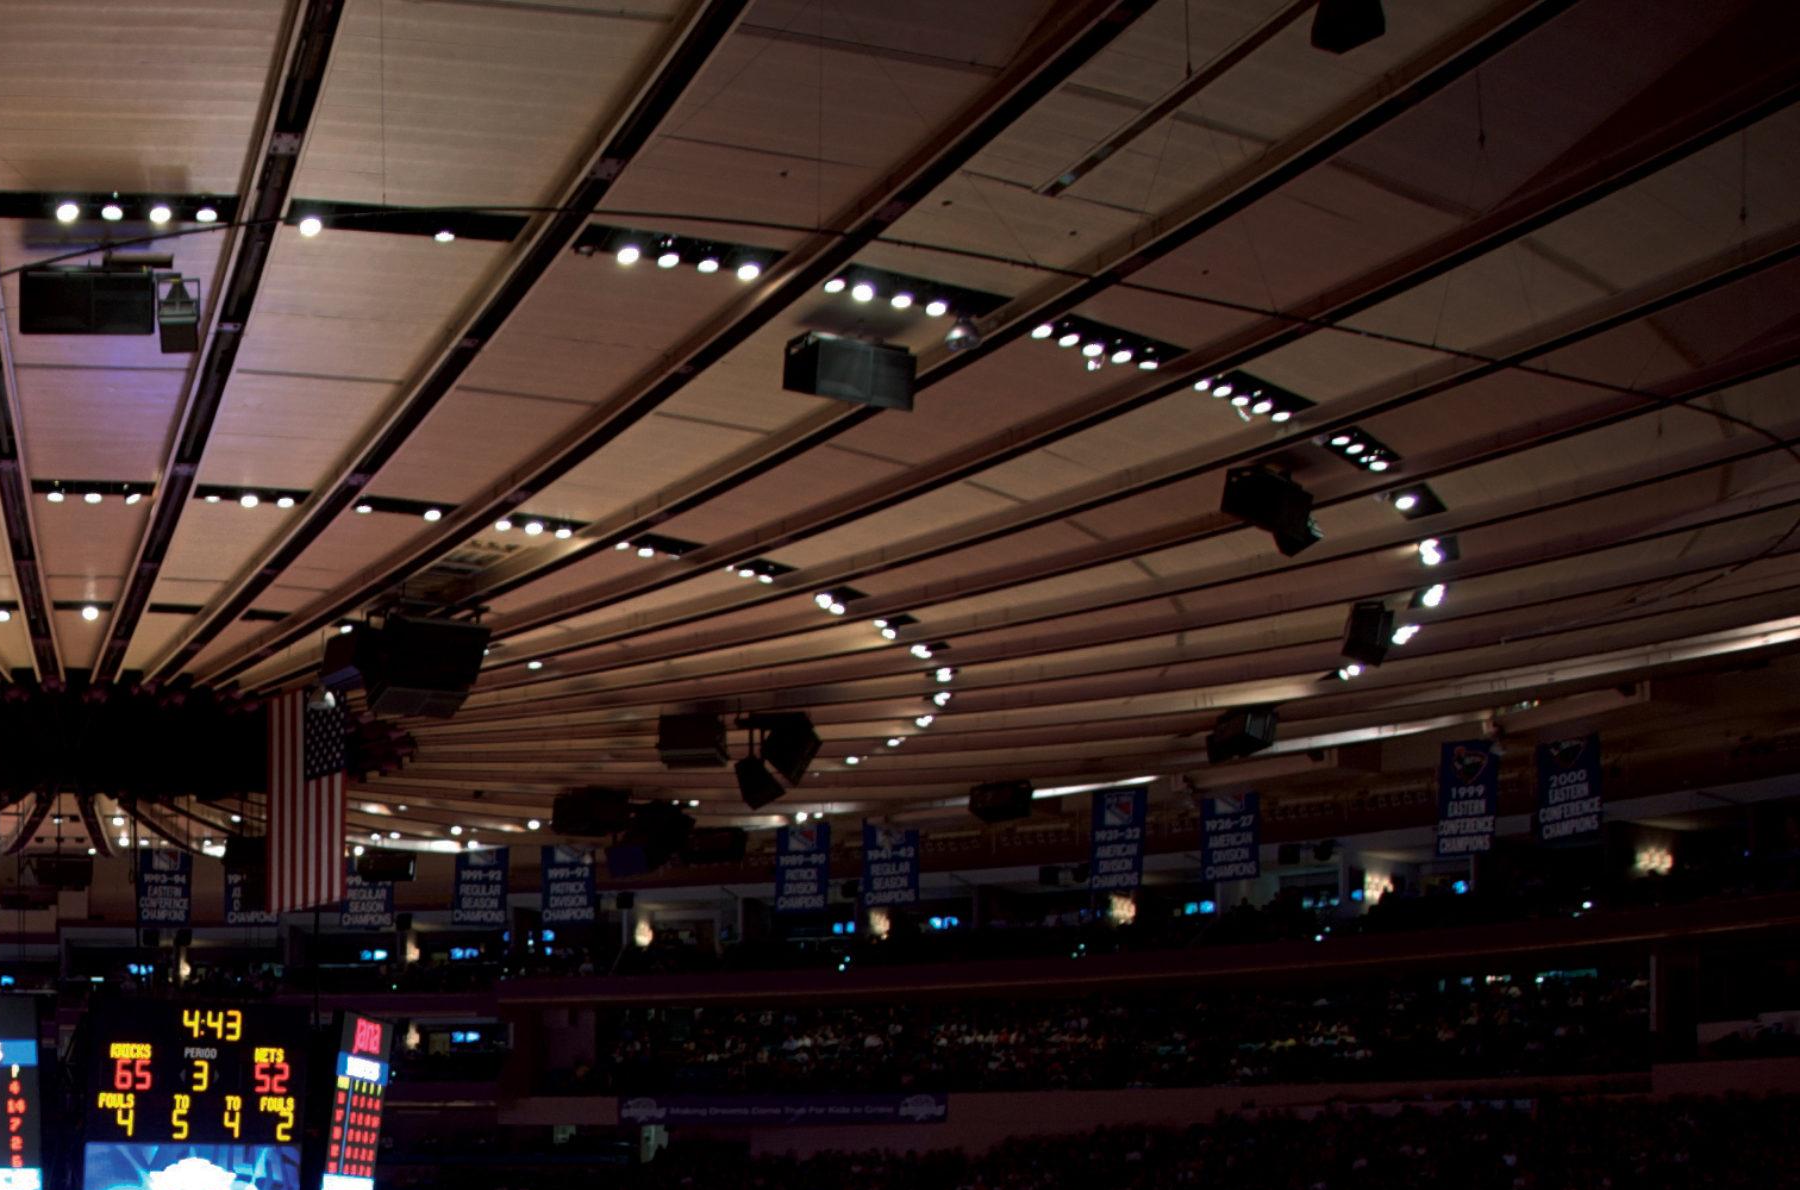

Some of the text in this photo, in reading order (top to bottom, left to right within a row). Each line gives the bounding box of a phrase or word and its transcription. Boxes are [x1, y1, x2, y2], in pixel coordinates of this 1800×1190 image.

[1549, 768, 1588, 789] 2000
[1451, 784, 1486, 800] 1999
[1548, 781, 1590, 805] EASTERN
[1447, 799, 1486, 818] EASTERN
[1539, 796, 1601, 824] CONFERENCE
[1437, 815, 1495, 836] CONFERENCE
[1541, 814, 1599, 841] CHAMPIONS
[1208, 831, 1253, 849] AMERICAN
[1438, 834, 1491, 854] CHAMPIONS
[1096, 842, 1138, 860] AMERICAN
[1212, 847, 1250, 864] DIVISION
[784, 867, 818, 880] PATRICK
[870, 862, 910, 877] REGULAR
[1098, 858, 1132, 874] DIVISION
[1204, 860, 1257, 880] CHAMPIONS
[550, 880, 587, 894] PATRICK
[783, 881, 818, 895] DIVISION
[872, 875, 909, 891] SEASON
[1091, 871, 1139, 889] CHAMPIONS
[459, 883, 501, 896] REGULAR
[864, 888, 916, 905] CHAMPIONS
[348, 900, 385, 913] SEASON
[461, 895, 499, 909] SEASON
[777, 894, 825, 910] CHAMPIONS
[140, 909, 187, 922] CHAMPIONS
[342, 912, 392, 926] CHAMPIONS
[453, 909, 506, 923] CHAMPIONS
[542, 907, 595, 922] CHAMPIONS
[183, 1010, 241, 1041] 4:43
[110, 1043, 152, 1059] KNICKS
[184, 1047, 217, 1060] PERIOD
[254, 1048, 284, 1064] NETS
[115, 1059, 152, 1090] 65
[192, 1060, 209, 1091] 3
[254, 1062, 290, 1093] 52
[9, 1080, 20, 1094] 4
[7, 1098, 25, 1114] 14
[98, 1092, 135, 1109] FOULS
[173, 1094, 190, 1109] TO
[225, 1096, 242, 1110] TO
[260, 1096, 295, 1112] FOULS
[9, 1117, 21, 1133] 7
[117, 1108, 135, 1137] 4
[172, 1109, 189, 1140] 5
[223, 1110, 241, 1139] 4
[276, 1111, 295, 1141] 2
